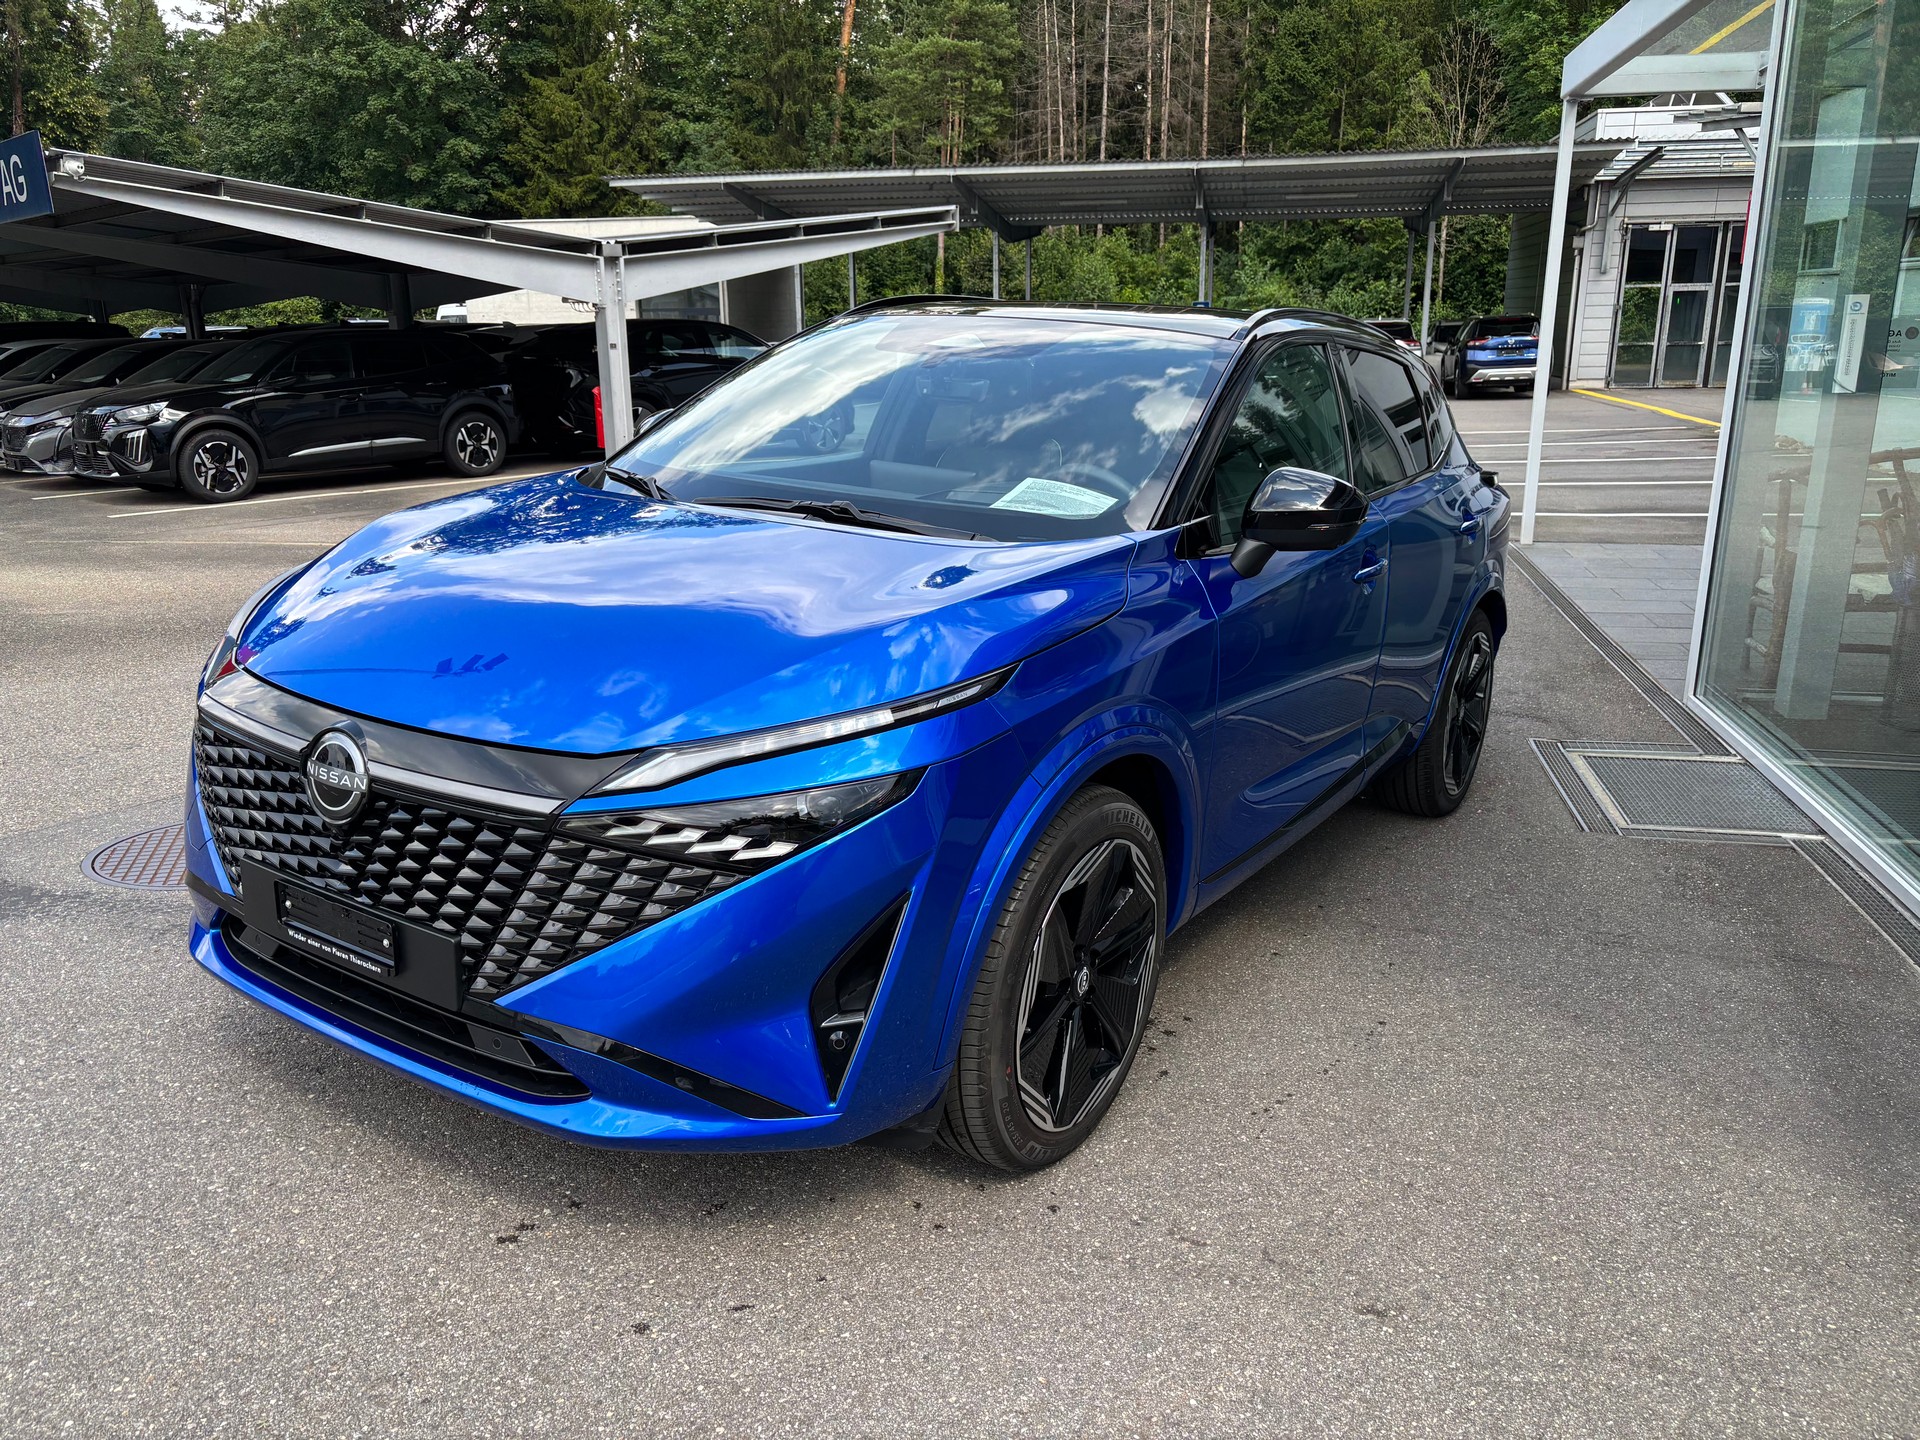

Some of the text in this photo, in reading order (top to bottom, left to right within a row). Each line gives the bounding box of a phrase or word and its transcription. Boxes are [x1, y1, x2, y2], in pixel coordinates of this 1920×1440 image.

[0, 154, 27, 206] AG
[307, 761, 367, 790] NISSAN
[1099, 809, 1151, 837] MICHELIN
[287, 928, 307, 942] Wieder
[307, 937, 320, 948] einer
[321, 944, 331, 953] von
